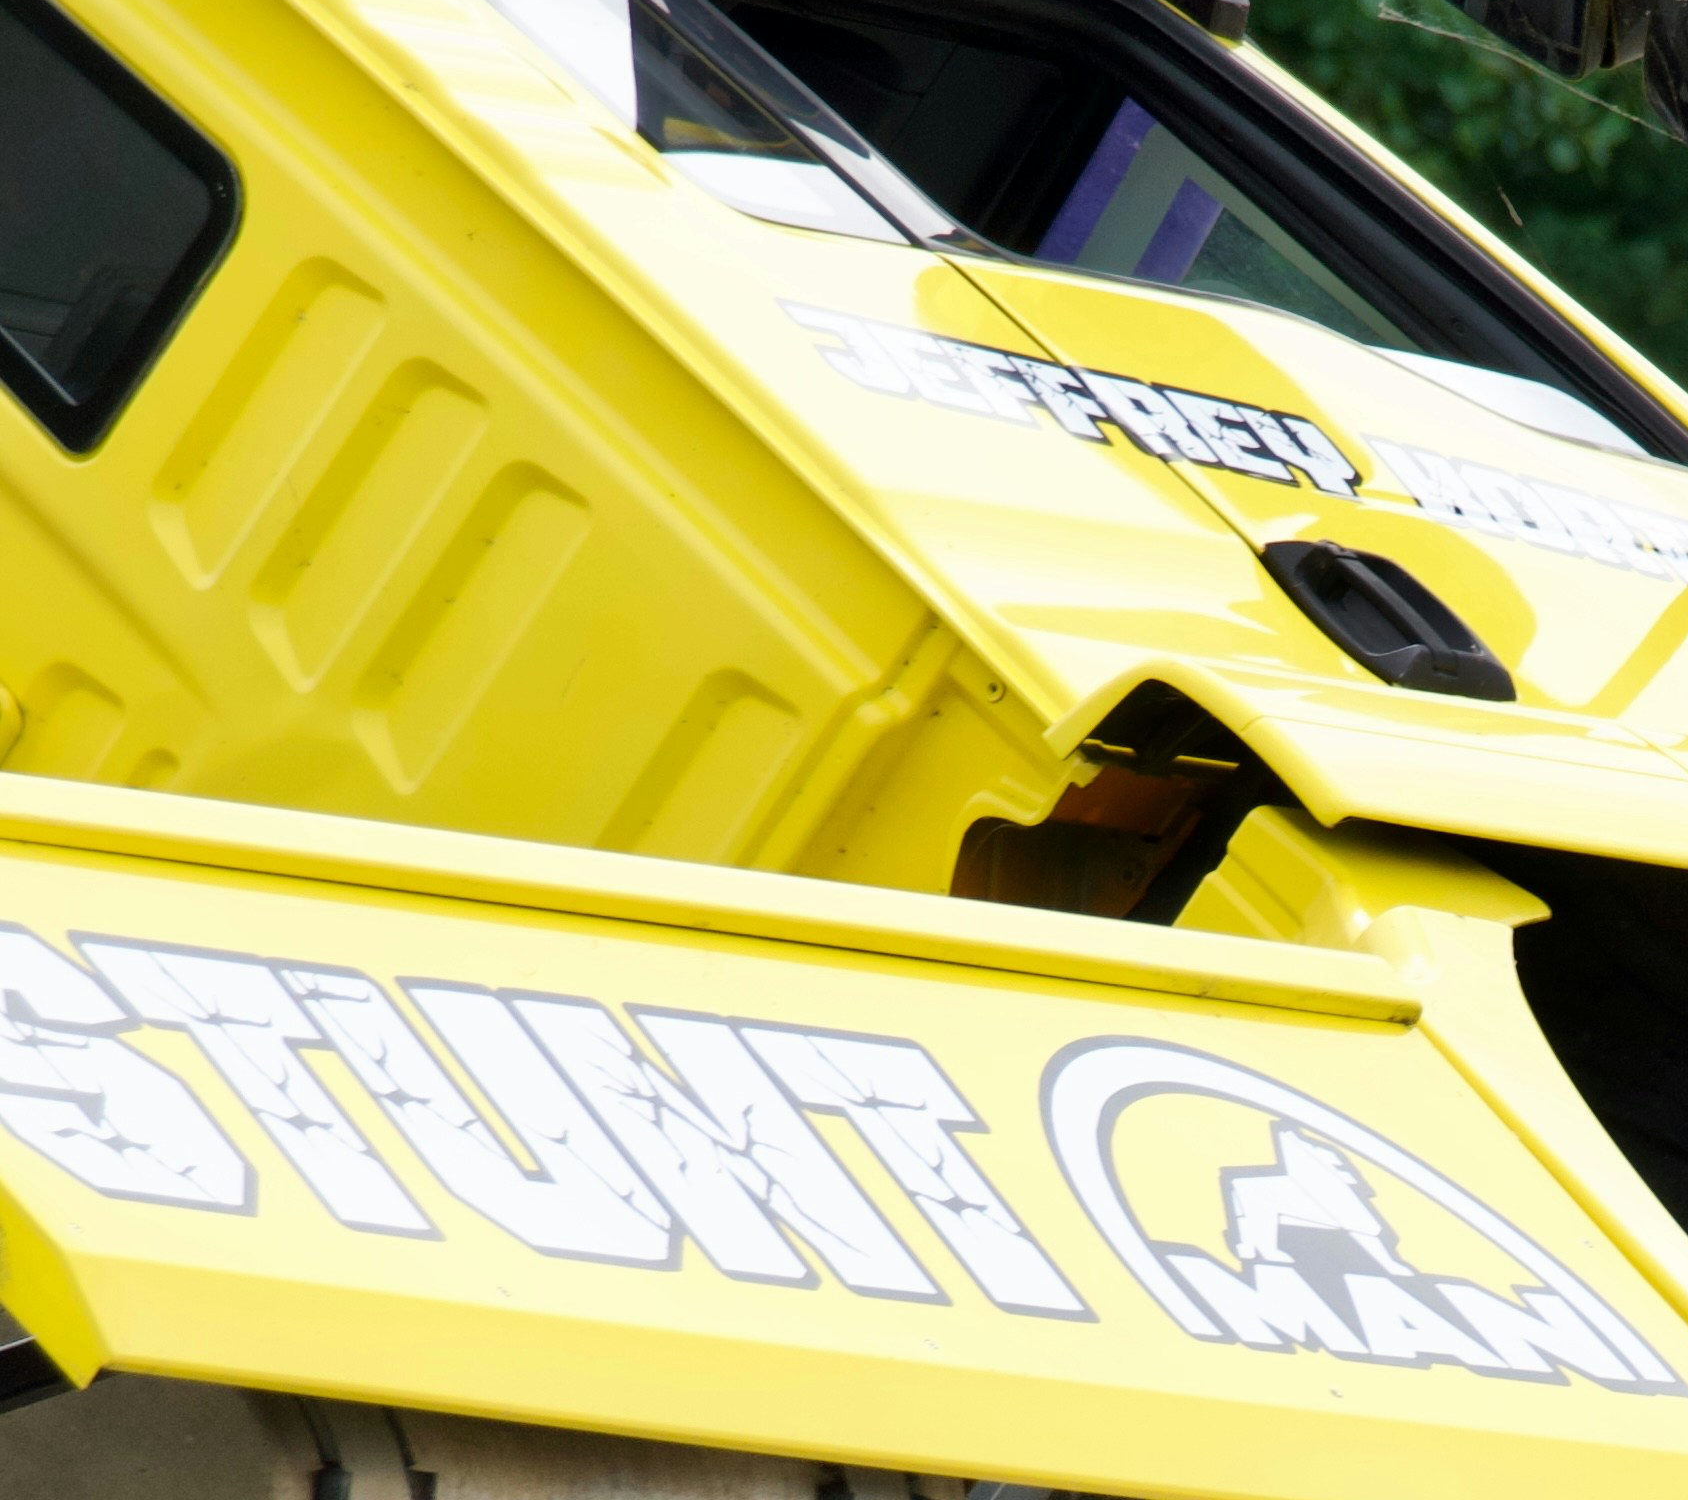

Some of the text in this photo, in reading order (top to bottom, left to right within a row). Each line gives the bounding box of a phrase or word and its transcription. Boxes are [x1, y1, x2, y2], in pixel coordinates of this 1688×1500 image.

[776, 297, 1363, 500] JEFFREY
[0, 921, 1642, 1390] STUNT MAN
